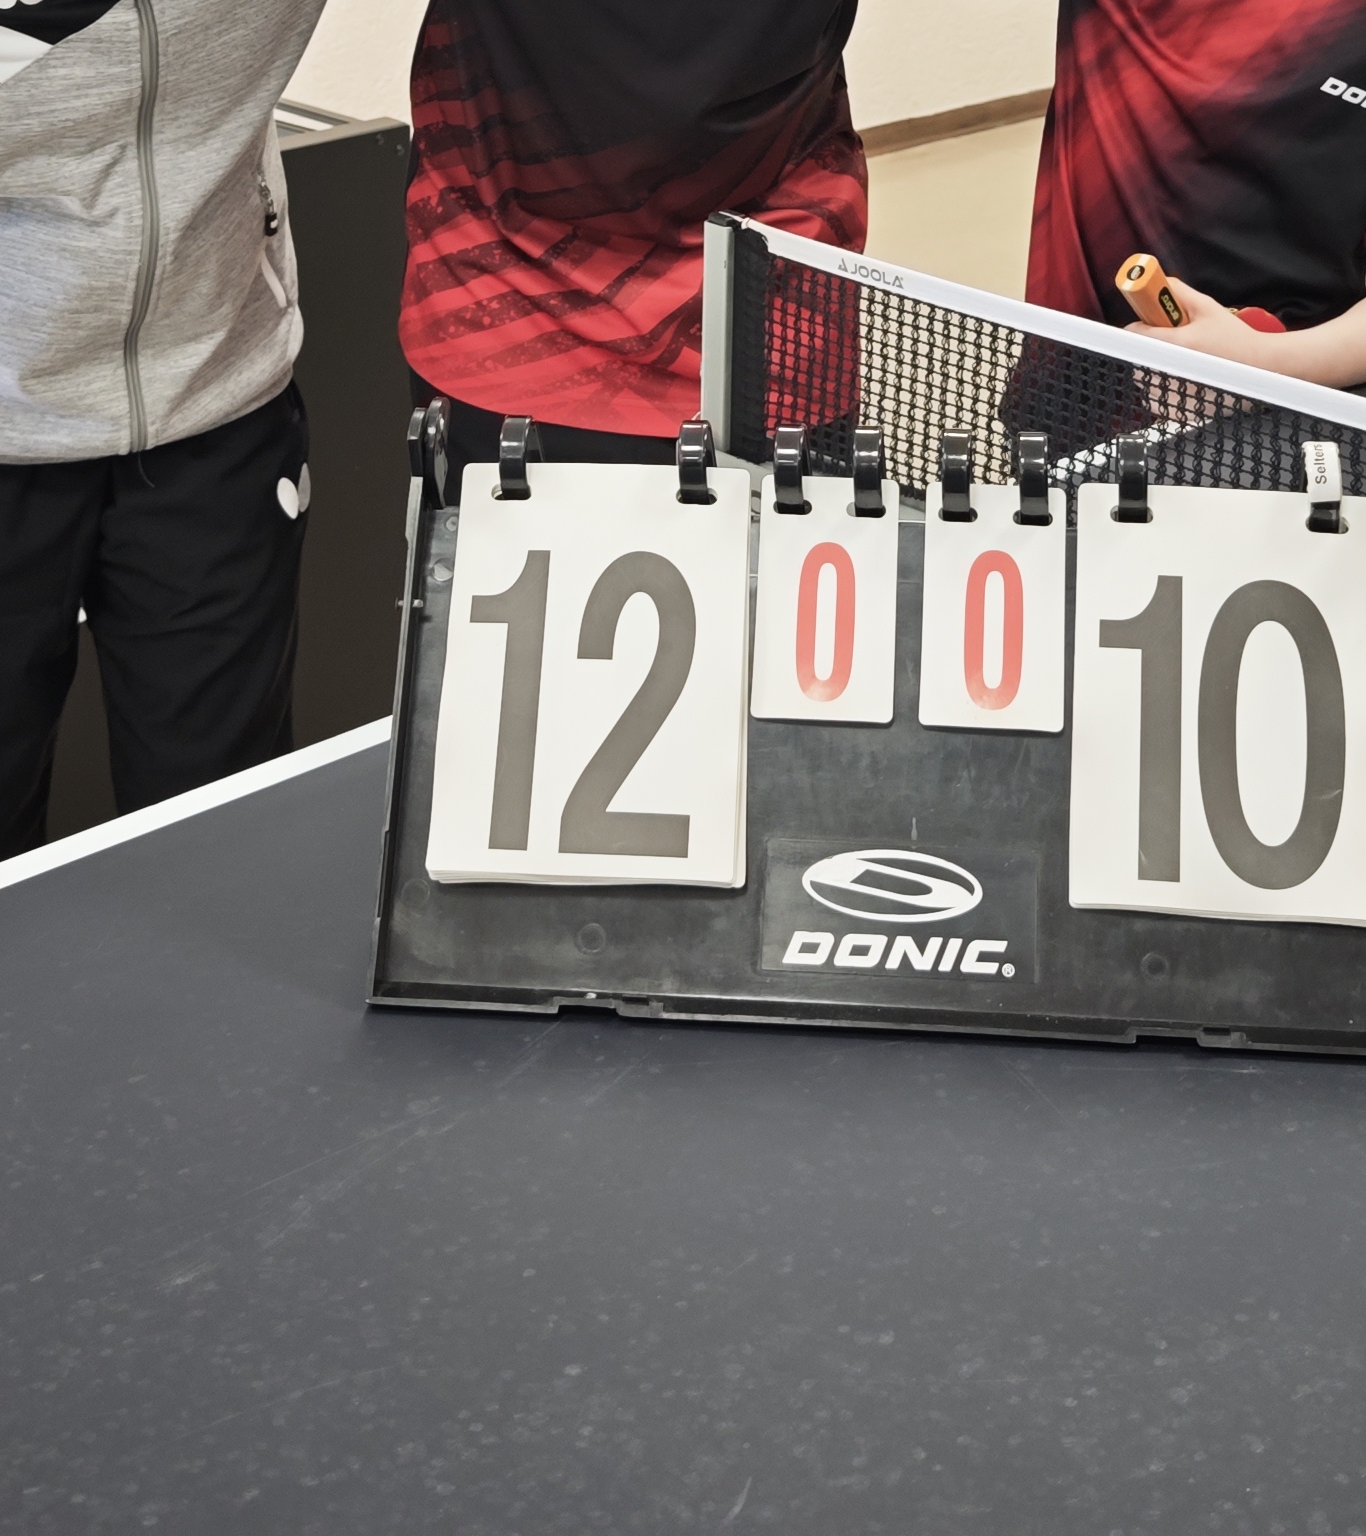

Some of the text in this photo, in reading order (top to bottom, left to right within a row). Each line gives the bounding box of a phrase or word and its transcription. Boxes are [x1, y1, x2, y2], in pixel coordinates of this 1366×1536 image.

[850, 263, 904, 290] JOOLA
[795, 542, 855, 702] 0
[964, 549, 1024, 712] 0
[469, 549, 697, 859] 12
[1099, 575, 1346, 890] 10
